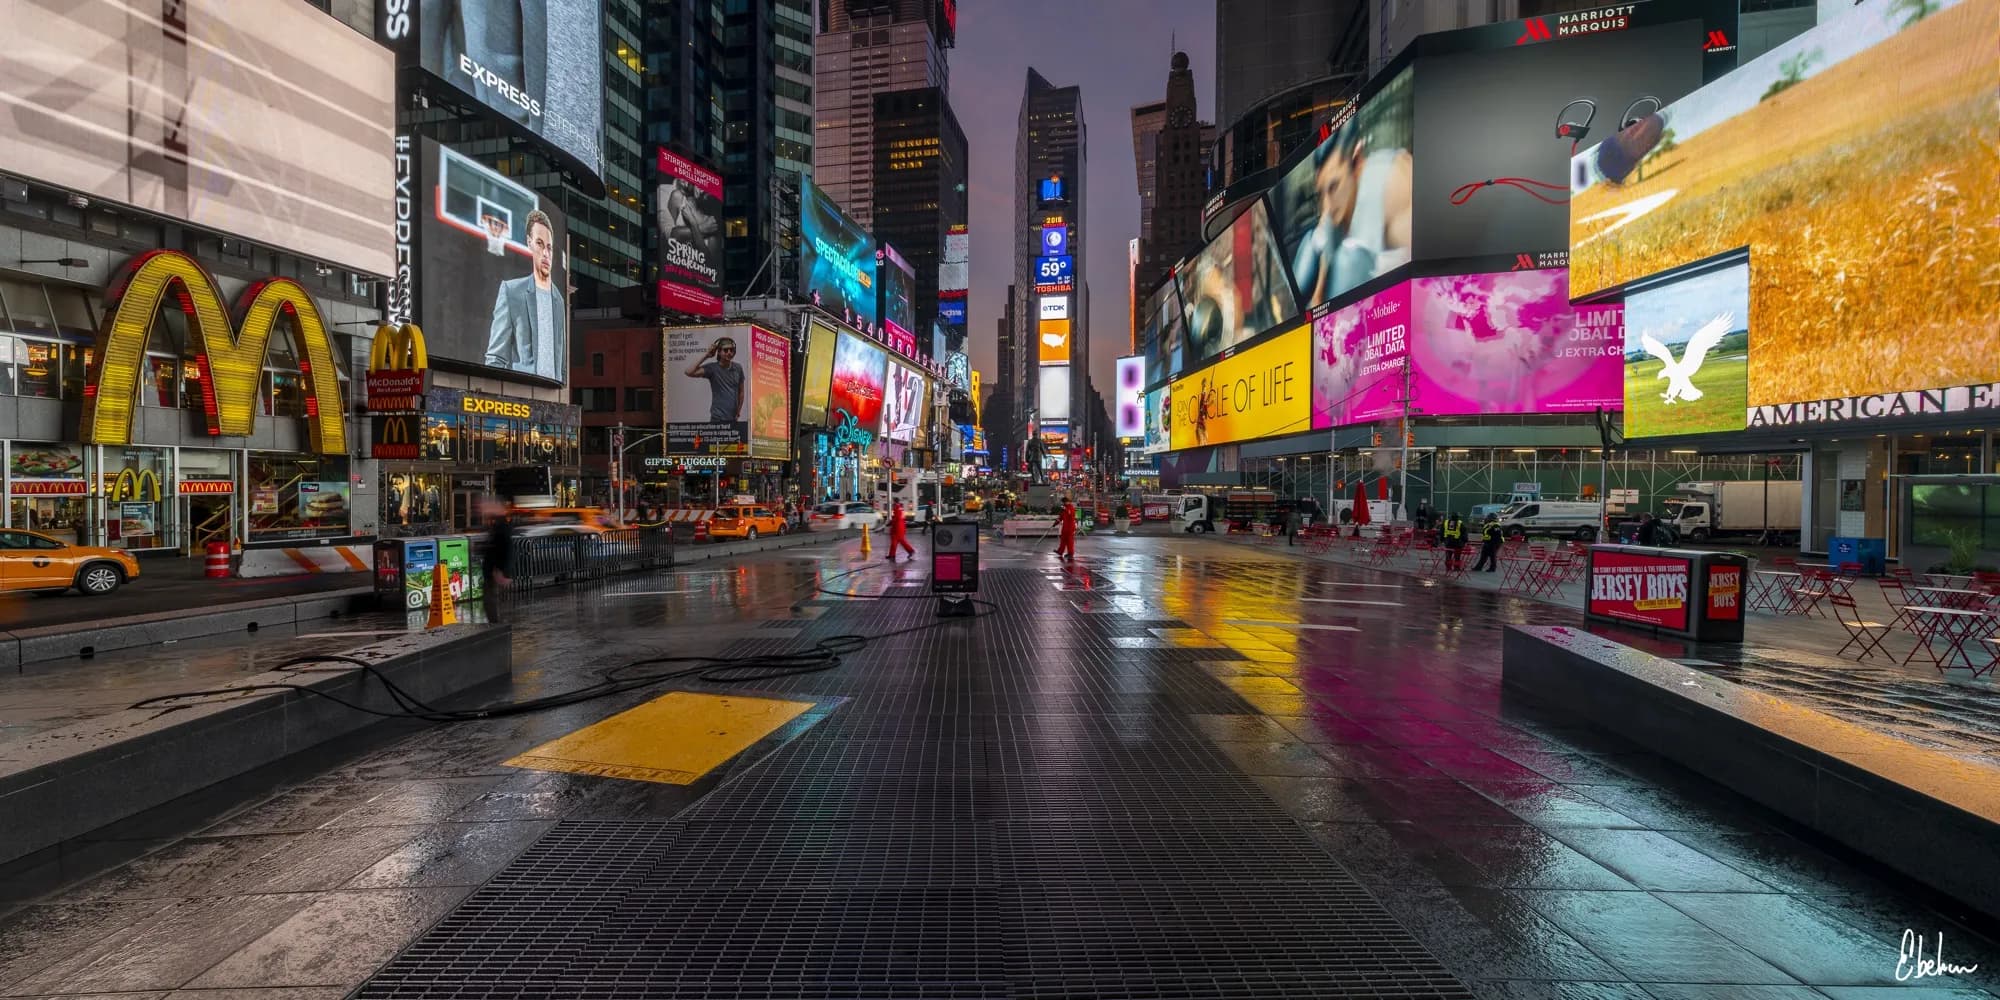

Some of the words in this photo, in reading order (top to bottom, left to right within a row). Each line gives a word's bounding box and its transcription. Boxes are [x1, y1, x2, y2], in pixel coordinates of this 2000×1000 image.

[1559, 5, 1635, 24] MARRIOTT
[1559, 18, 1625, 36] MARQUIS
[460, 53, 541, 117] EXPRESS
[1331, 93, 1360, 124] MARRIOTT
[1331, 105, 1356, 133] MARQUIS
[668, 238, 706, 264] SPRING
[1540, 252, 1568, 260] MARRI
[666, 252, 718, 282] awakening
[1041, 262, 1067, 277] 59°
[1036, 285, 1072, 293] TOSHIBA
[845, 308, 884, 342] 1540
[1386, 339, 1405, 356] DATA
[1566, 347, 1605, 358] EXTRA
[1363, 364, 1380, 376] EXTRA
[1381, 356, 1405, 371] CHARGE
[368, 377, 421, 388] McDonald's
[1234, 374, 1256, 412] OF
[1264, 361, 1294, 406] LIFE
[463, 397, 531, 418] EXPRESS
[1751, 388, 1947, 427] AMERICAN
[645, 458, 672, 466] GIFTS
[680, 458, 727, 466] LUGGAGE
[1591, 574, 1642, 601] JERSEY
[1647, 573, 1688, 602] BOYS
[1710, 572, 1740, 588] JERSEY
[1713, 593, 1736, 607] BOYS
